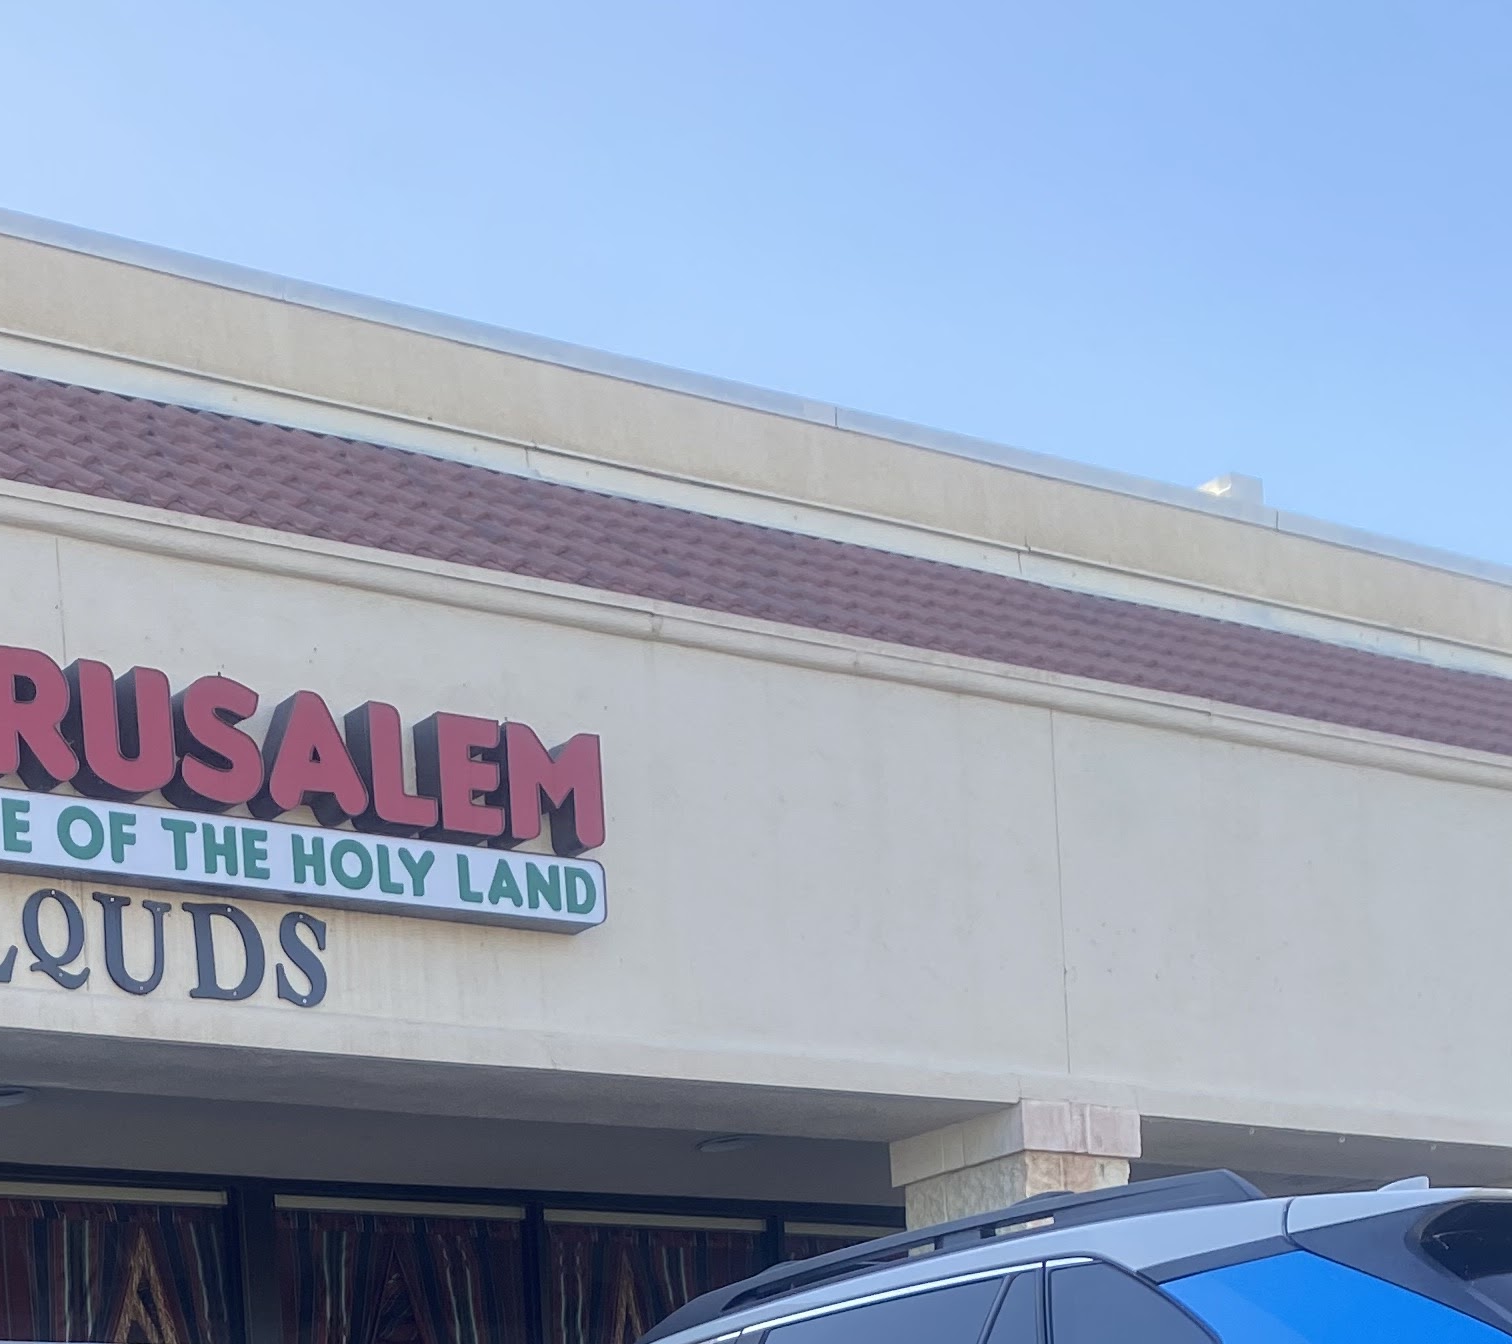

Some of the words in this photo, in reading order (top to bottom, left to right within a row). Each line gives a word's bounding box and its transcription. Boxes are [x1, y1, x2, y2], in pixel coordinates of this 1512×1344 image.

[56, 804, 138, 864] OF
[160, 816, 271, 880] THE
[290, 832, 436, 898] HOLY
[456, 852, 597, 916] LAND
